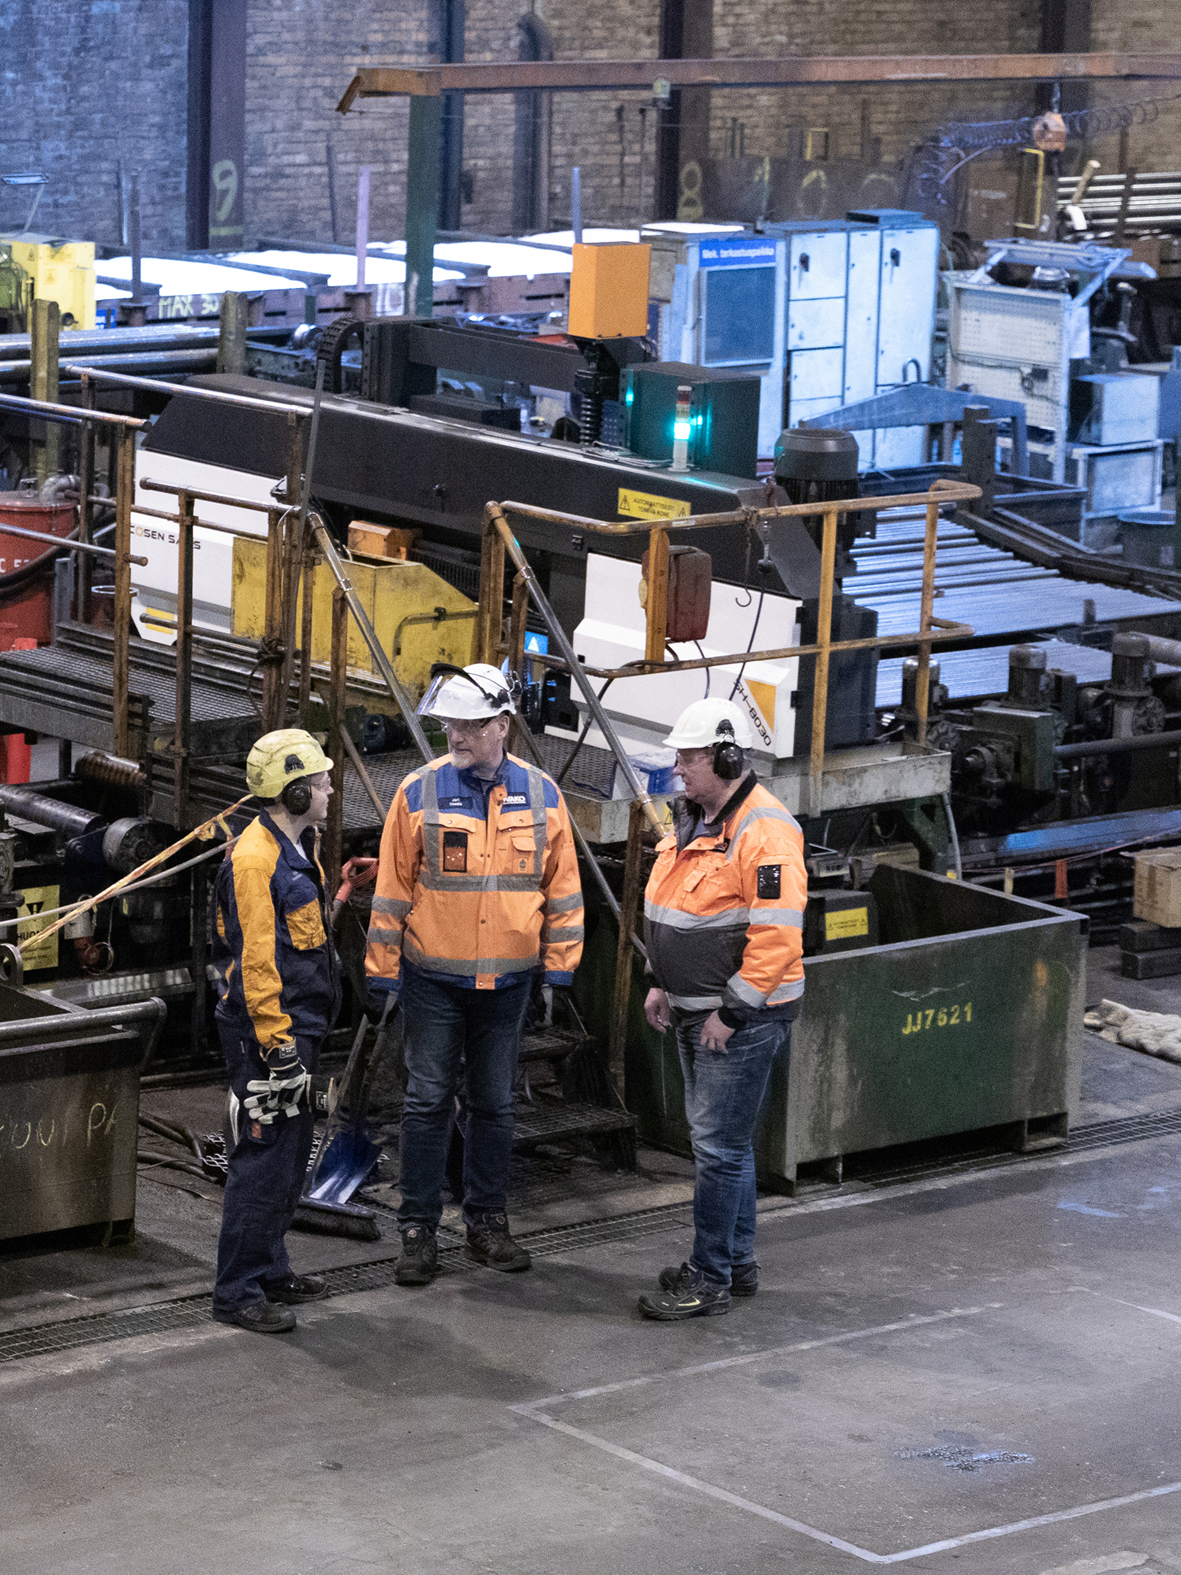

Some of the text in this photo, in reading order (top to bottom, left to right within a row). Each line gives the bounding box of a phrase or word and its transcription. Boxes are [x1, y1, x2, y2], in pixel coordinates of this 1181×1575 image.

[212, 160, 238, 221] 9
[159, 294, 194, 319] MAX
[168, 534, 201, 550] SS
[733, 680, 771, 746] SH-8030
[902, 1002, 972, 1035] JJ7621
